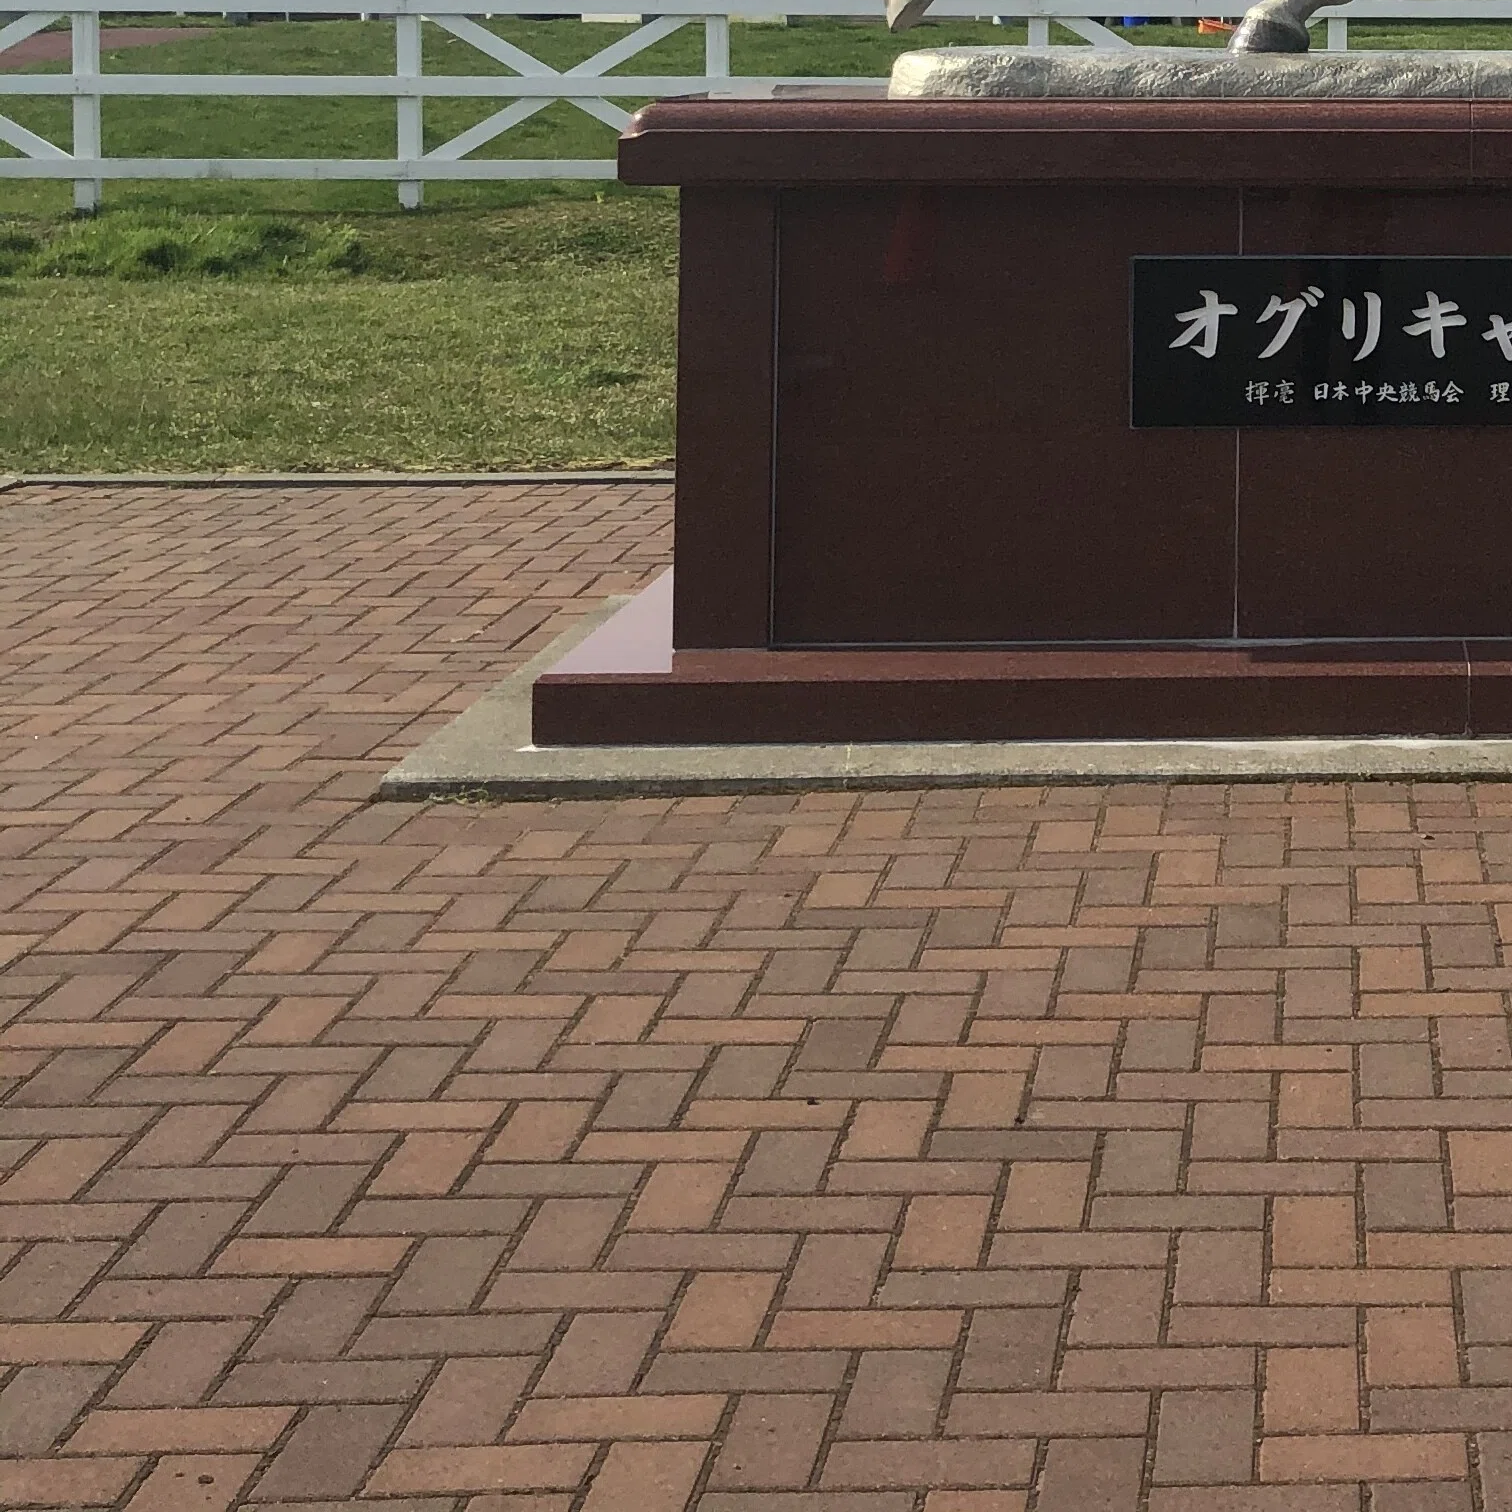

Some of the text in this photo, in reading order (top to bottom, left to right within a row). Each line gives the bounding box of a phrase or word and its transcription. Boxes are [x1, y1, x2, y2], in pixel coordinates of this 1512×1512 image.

[1246, 380, 1294, 405] 揮毫
[1315, 381, 1464, 404] 日本中央競馬会
